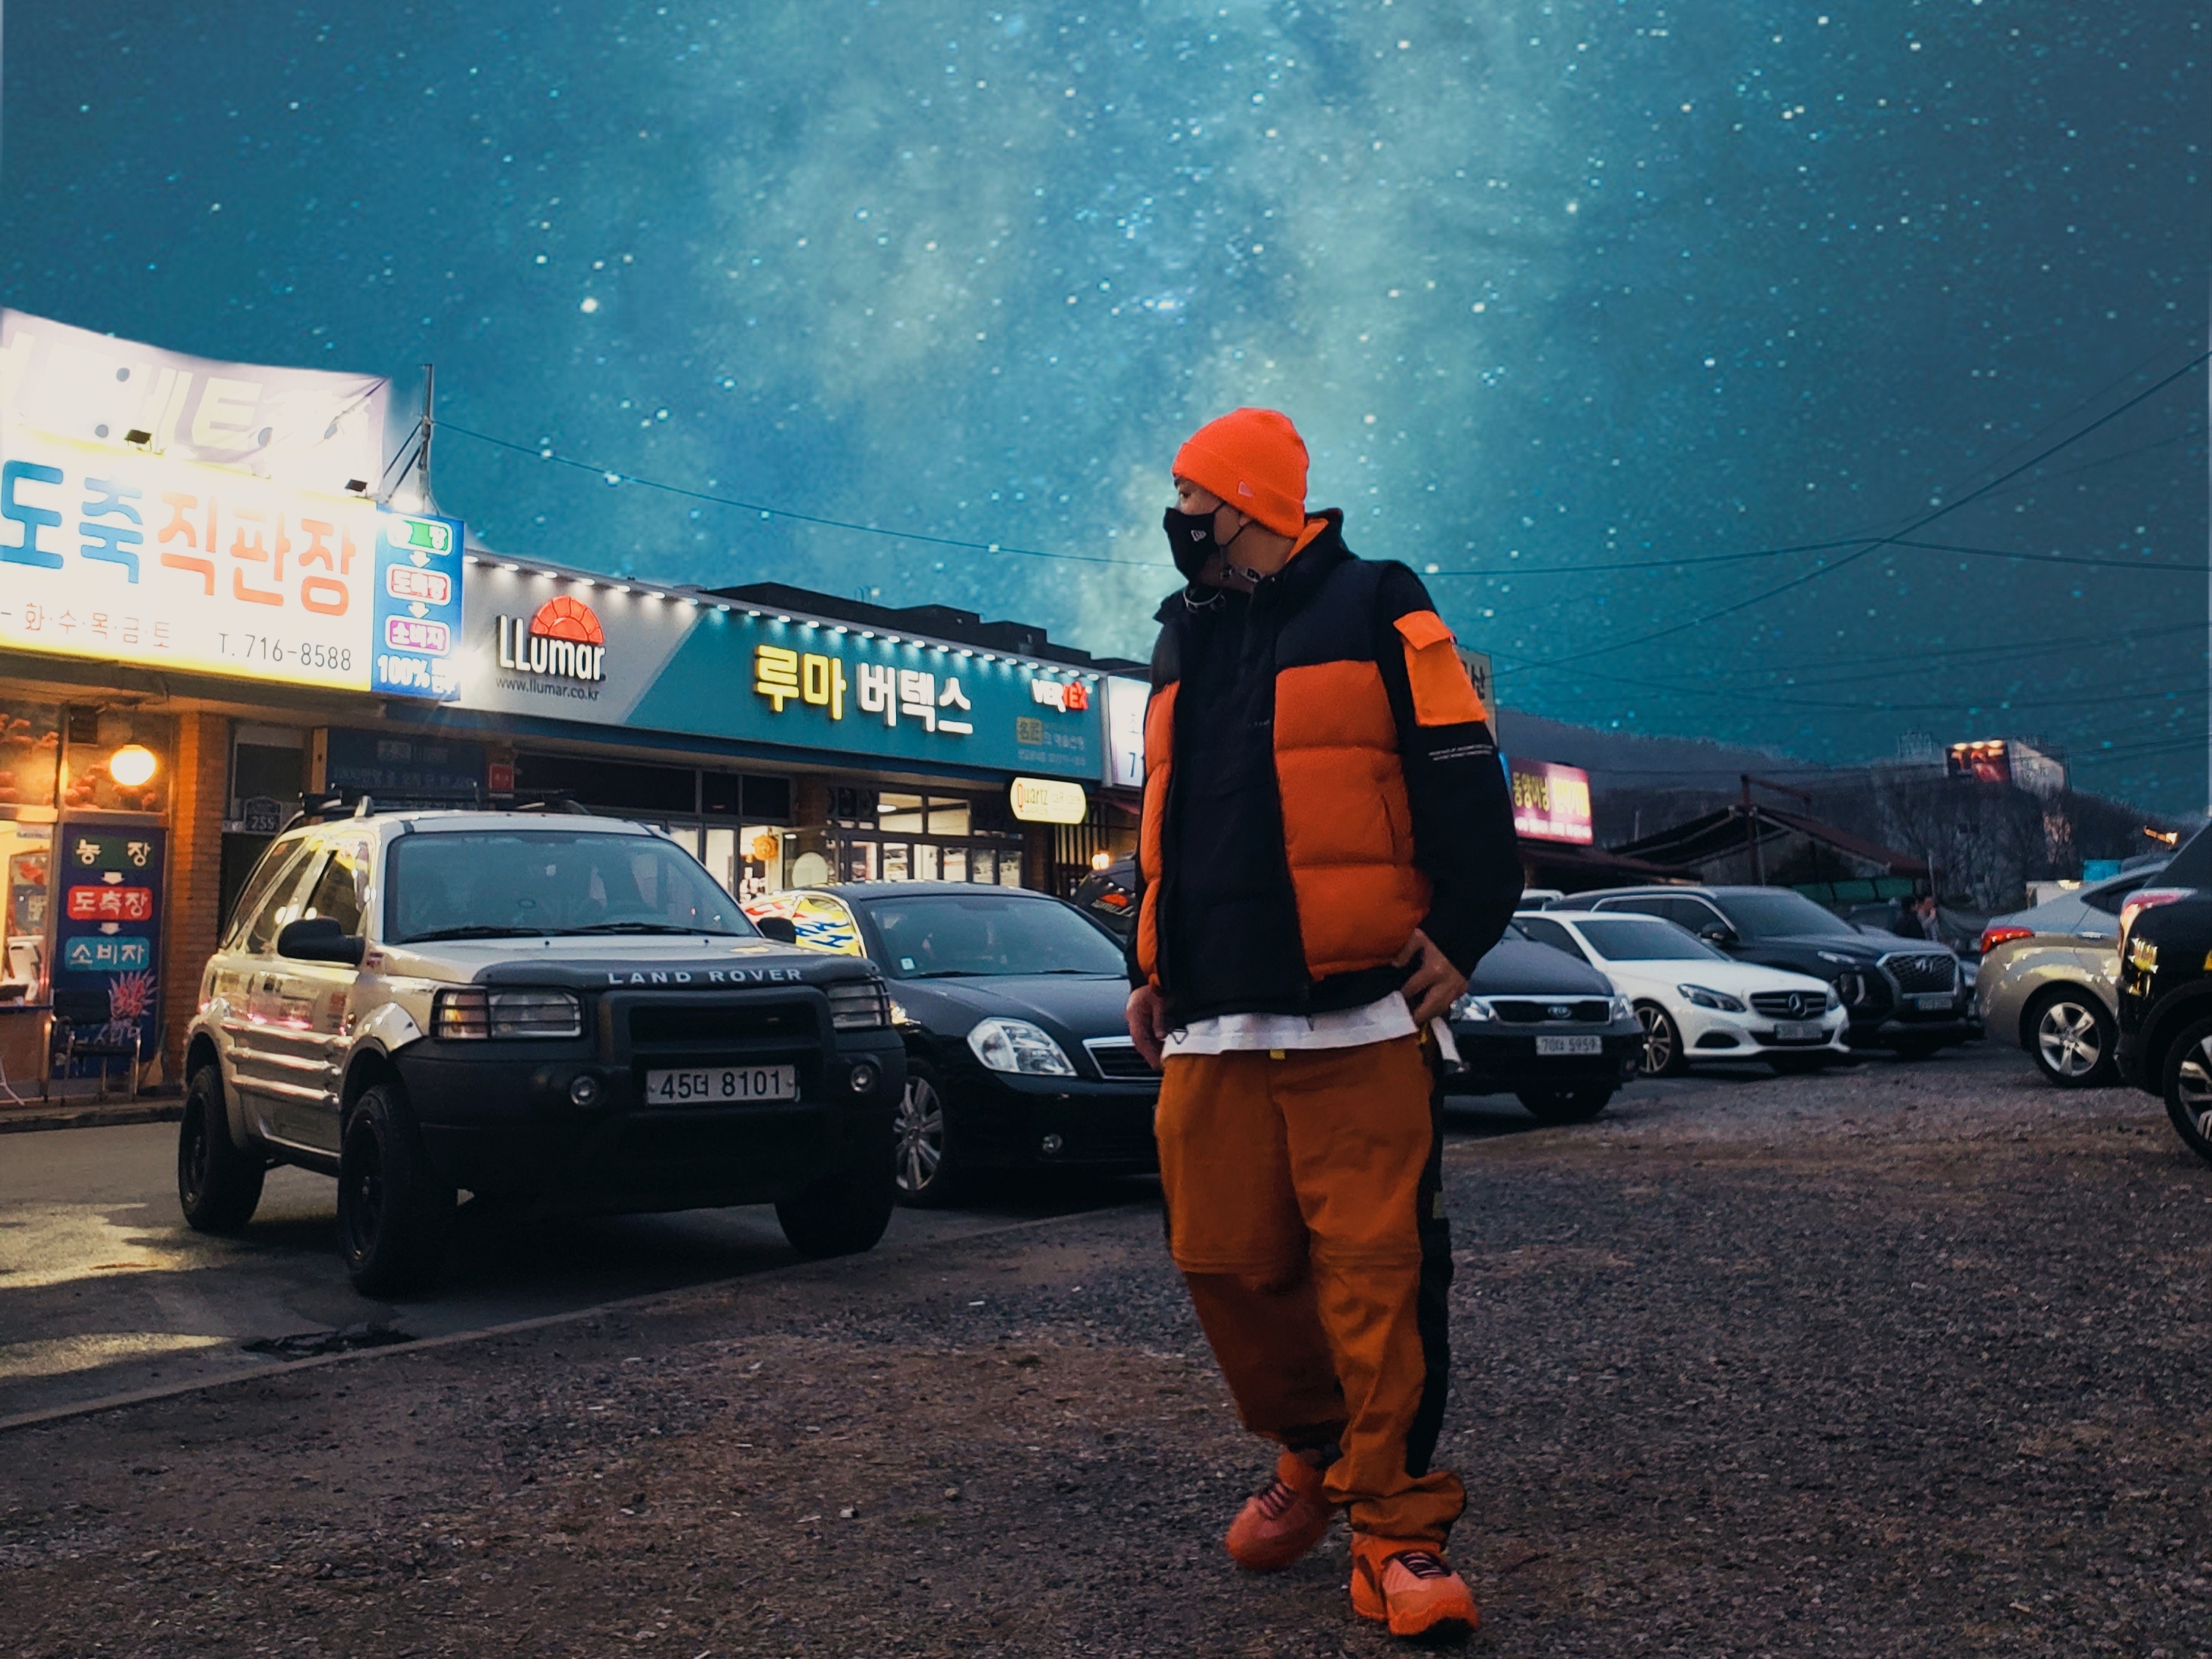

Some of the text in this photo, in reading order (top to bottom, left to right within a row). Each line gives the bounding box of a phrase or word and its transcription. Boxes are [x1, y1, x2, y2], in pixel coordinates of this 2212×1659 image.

[496, 614, 606, 682] LLumar
[377, 654, 431, 689] 100%
[496, 676, 600, 702] www.llumar.co.kr
[755, 644, 974, 734] 루마 버텍스
[1017, 783, 1048, 812] Quartz
[73, 890, 147, 917] 도축장
[70, 944, 145, 966] 소비자
[608, 968, 802, 985] LAND ROVER
[722, 1070, 780, 1098] 8101
